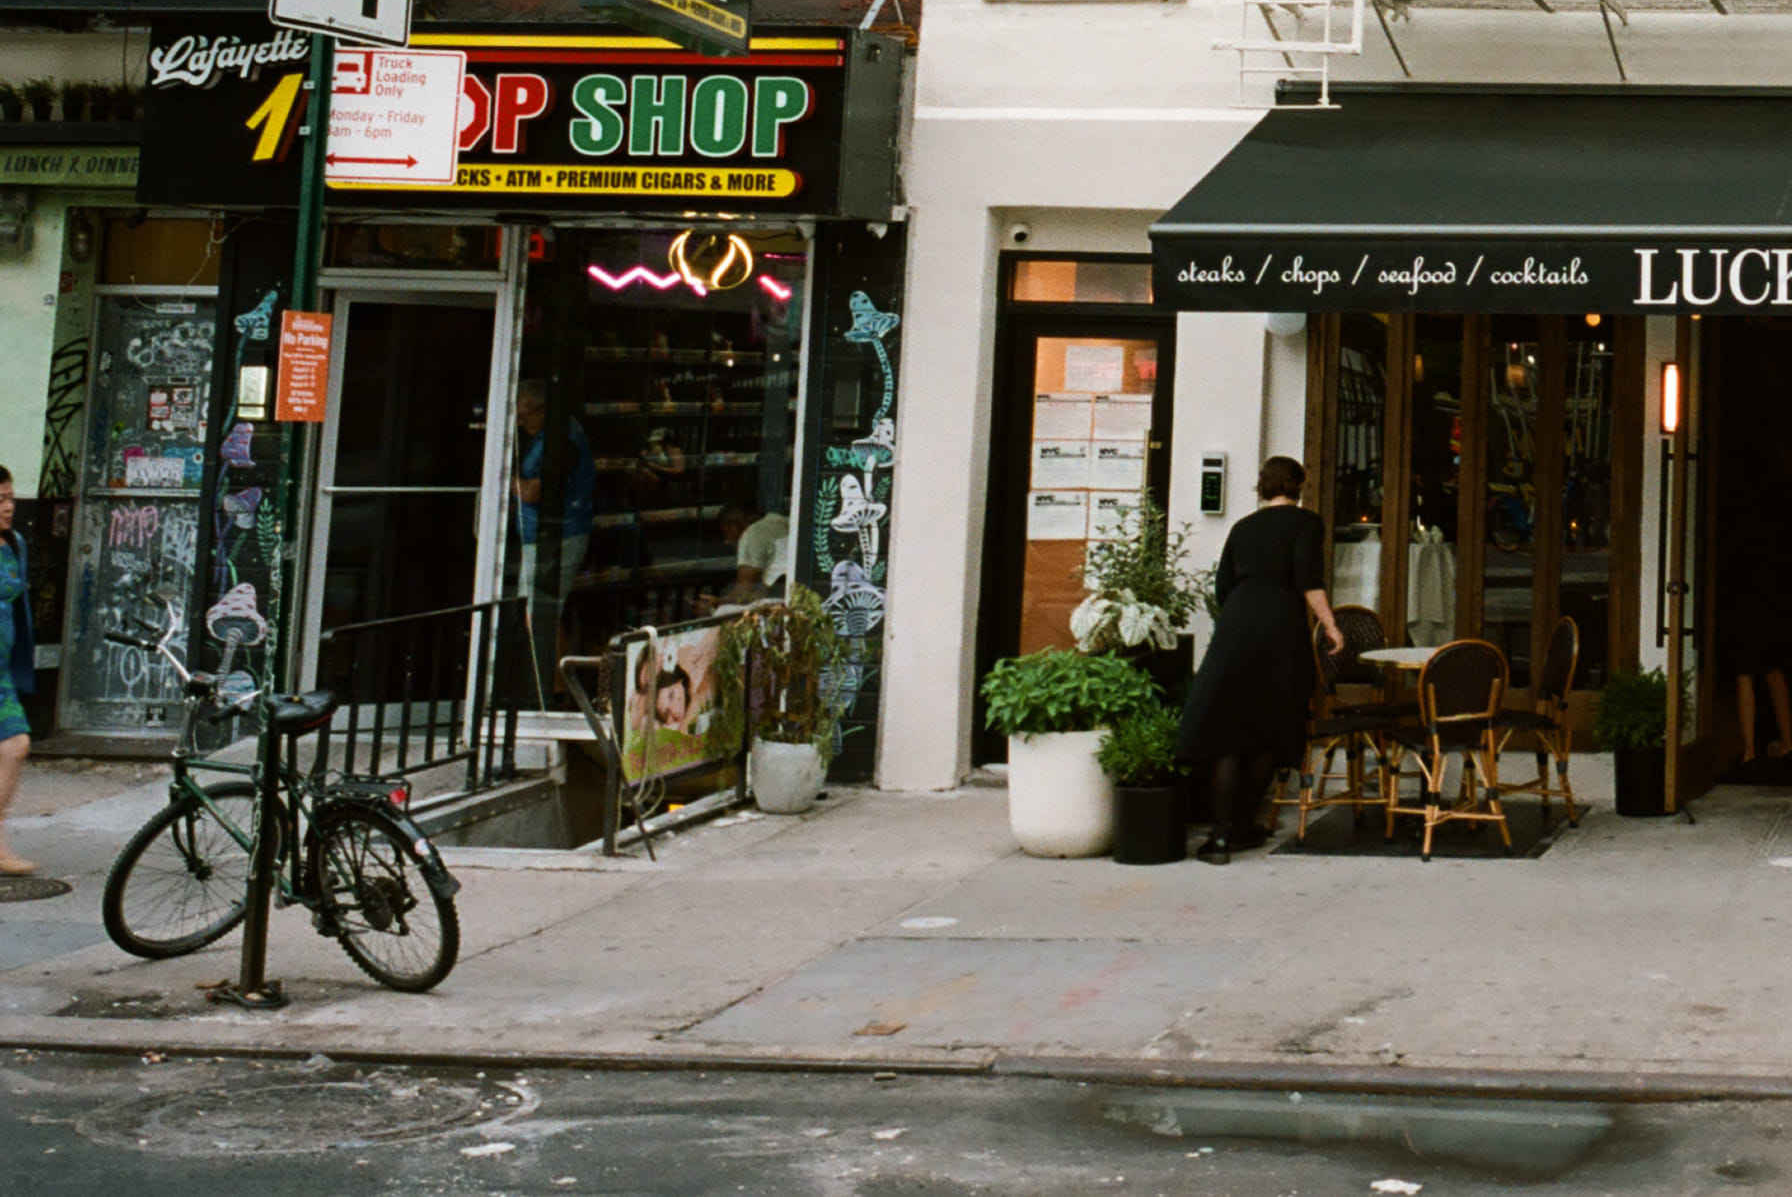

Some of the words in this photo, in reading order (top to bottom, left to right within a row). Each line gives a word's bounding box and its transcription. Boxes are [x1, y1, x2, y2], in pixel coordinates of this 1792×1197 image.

[377, 56, 413, 70] Truck
[375, 71, 427, 87] Loading
[374, 84, 405, 99] Only
[245, 72, 304, 162] 1
[569, 73, 809, 158] SHOP
[387, 110, 426, 125] Friday
[364, 125, 393, 140] 6pm
[4, 154, 63, 173] LUNCH
[456, 168, 491, 187] CKS
[506, 170, 541, 188] ATM
[556, 170, 637, 189] PREMIUM
[640, 171, 706, 190] CIGARS
[709, 174, 723, 191] &
[727, 173, 776, 192] MORE
[1177, 257, 1246, 284] steaks
[1280, 255, 1341, 296] chops
[1377, 256, 1458, 297] seafood
[1490, 256, 1590, 287] cocktails
[284, 332, 297, 345] No
[298, 333, 329, 351] Parking
[1041, 447, 1060, 455] NYC
[1099, 447, 1118, 456] NYC
[1035, 495, 1055, 503] NYC
[1099, 498, 1118, 506] NYC
